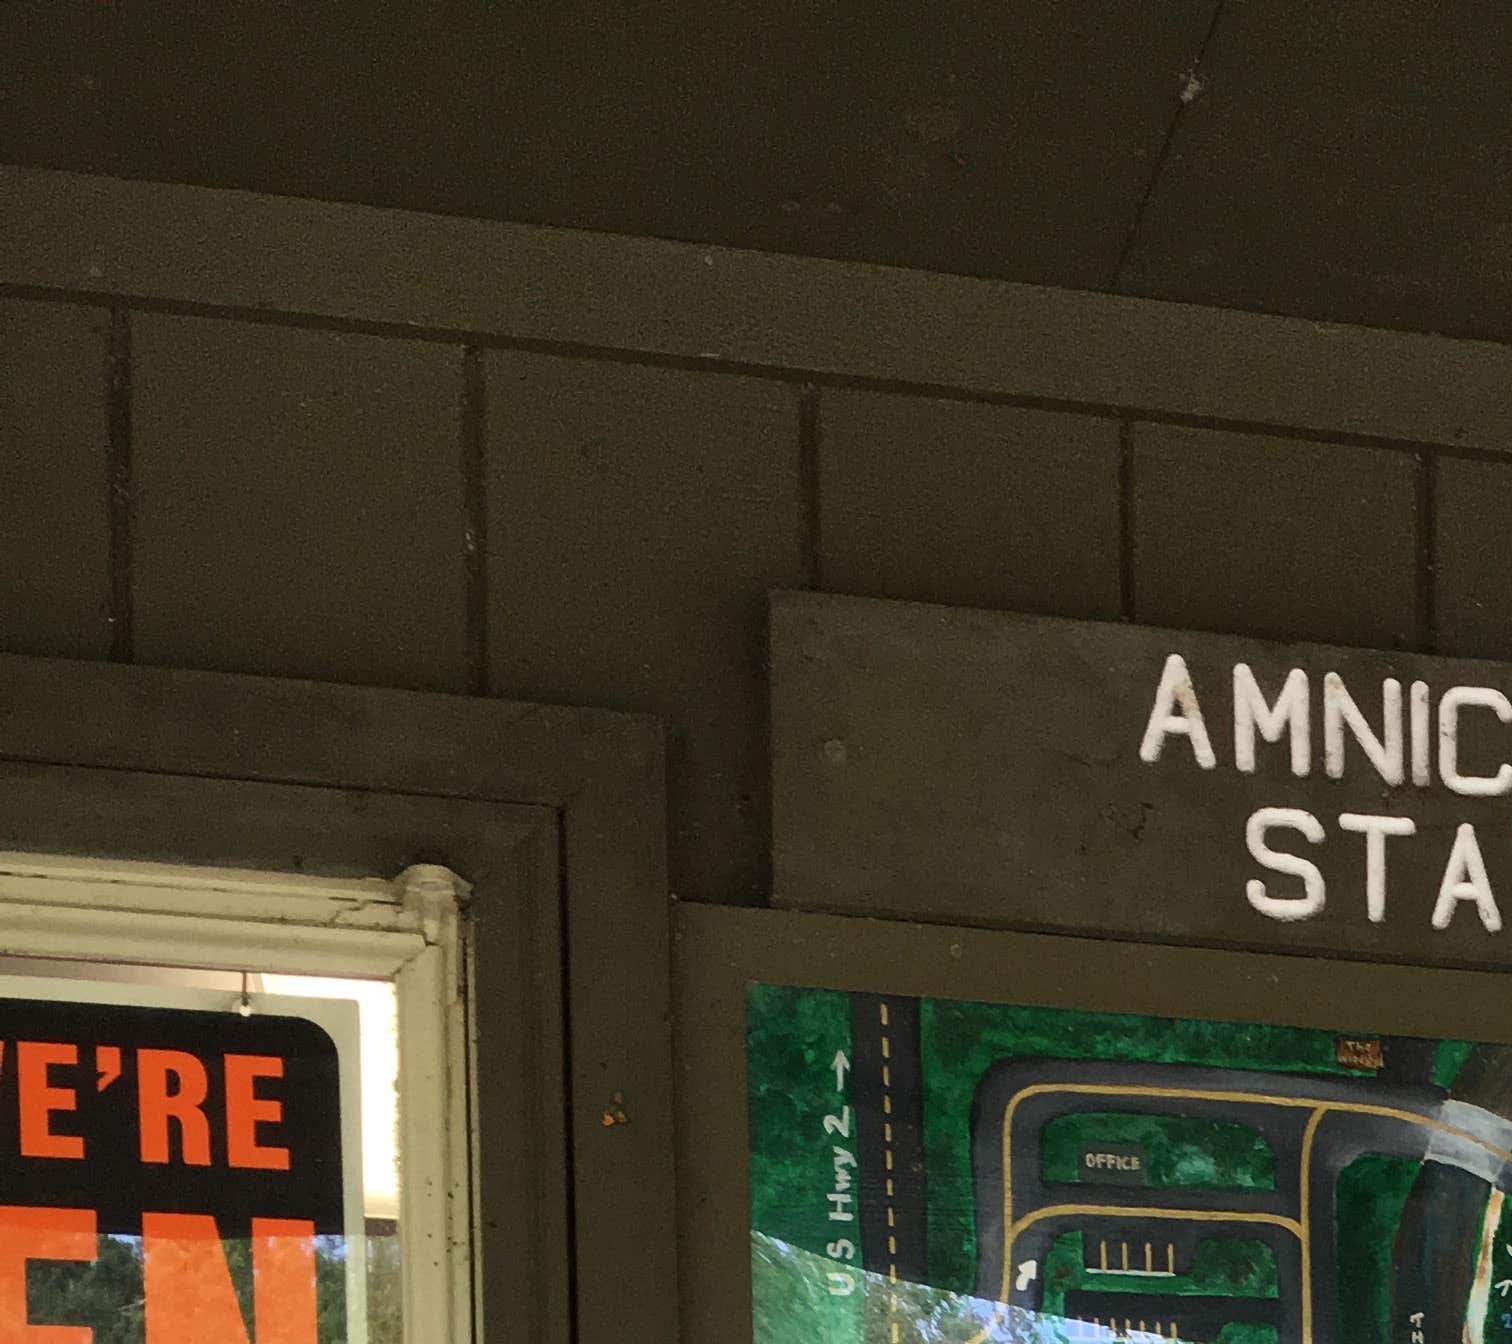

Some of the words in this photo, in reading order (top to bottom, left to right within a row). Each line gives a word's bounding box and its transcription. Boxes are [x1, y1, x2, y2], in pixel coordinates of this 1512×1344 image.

[0, 1040, 290, 1171] E'RE
[823, 1105, 850, 1138] 2
[826, 1146, 858, 1221] Hwy
[1086, 1153, 1141, 1170] OFFICE
